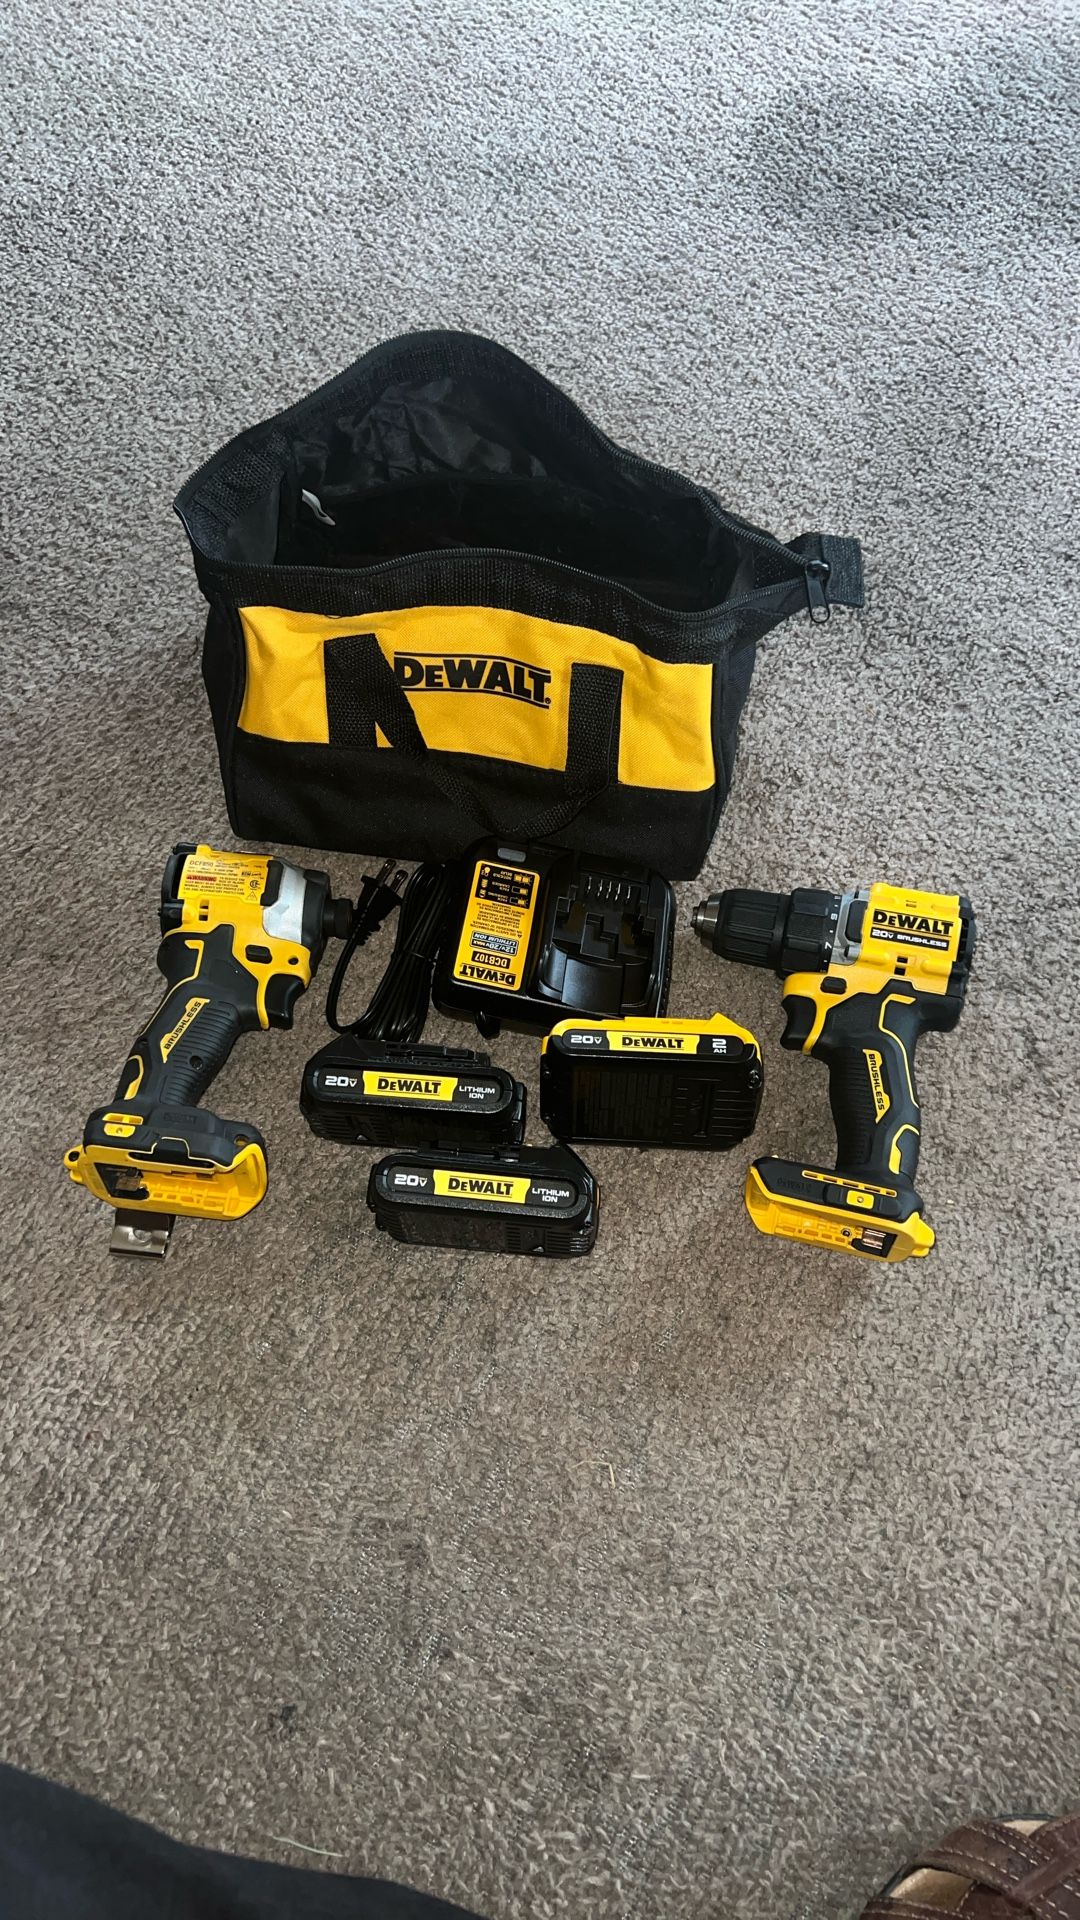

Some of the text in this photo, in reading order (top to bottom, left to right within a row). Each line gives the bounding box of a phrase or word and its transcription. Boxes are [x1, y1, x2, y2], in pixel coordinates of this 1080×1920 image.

[394, 655, 551, 704] DEWALT
[873, 909, 954, 935] DEWALT
[474, 933, 516, 946] LITHIUM ION
[897, 934, 947, 948] BRUSHLESS
[474, 952, 508, 966] DCB107
[459, 965, 516, 987] DEWALT
[164, 1001, 202, 1050] BRUSHLESS
[622, 1036, 684, 1049] DEWALT
[712, 1038, 727, 1049] 2
[377, 1078, 441, 1094] DEWALT
[459, 1085, 496, 1095] LITHIUM
[868, 1053, 885, 1111] BRUSHLESS
[448, 1177, 514, 1196] DEWALT
[532, 1187, 570, 1198] LITHIUM
[542, 1195, 558, 1203] ION
